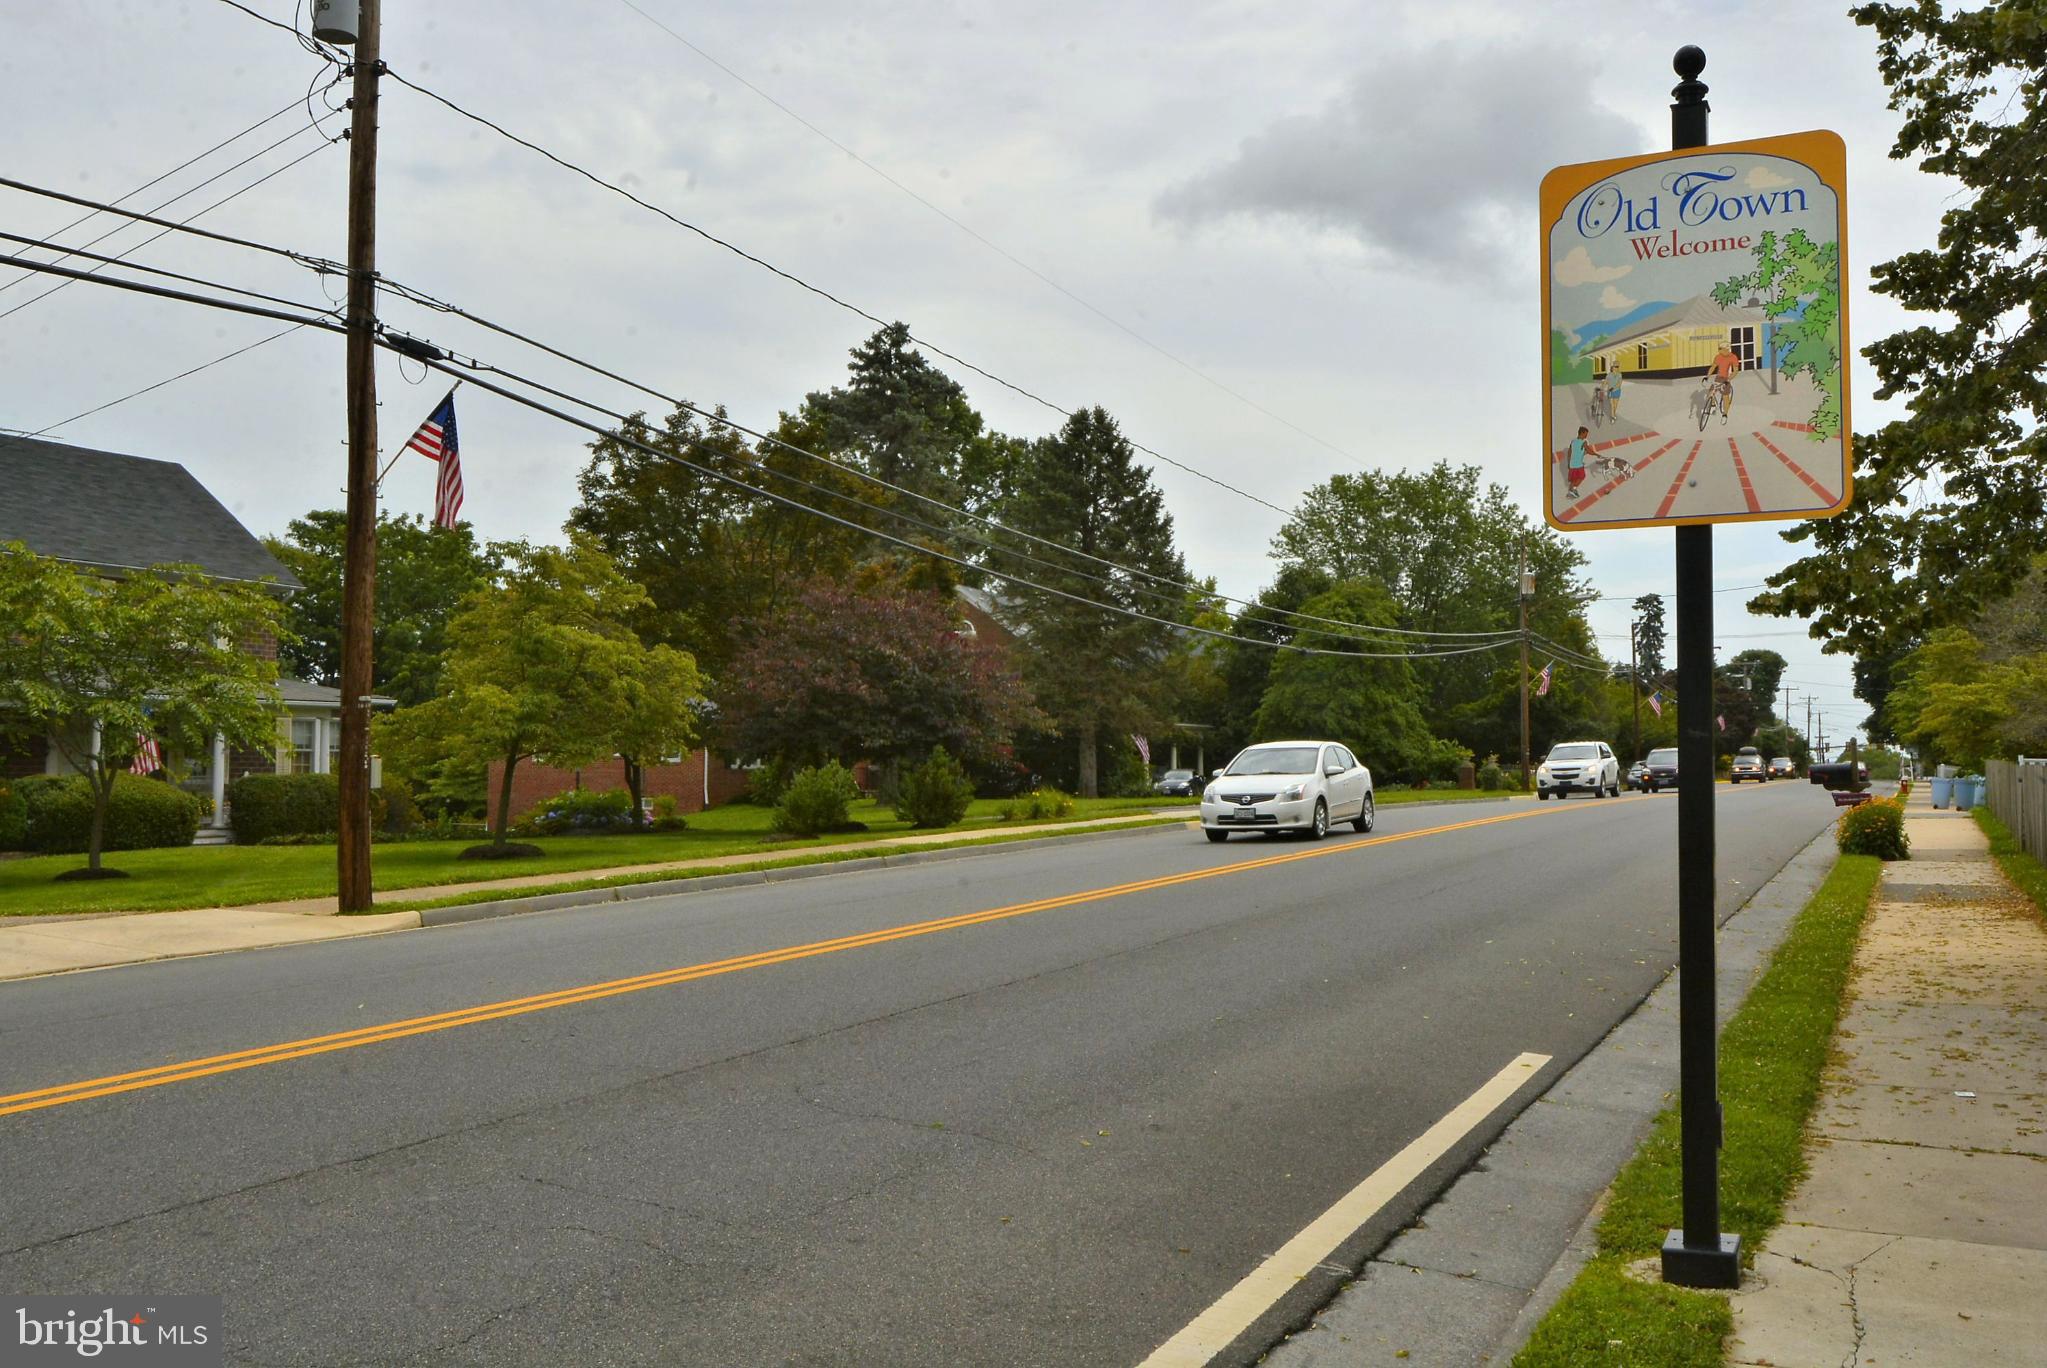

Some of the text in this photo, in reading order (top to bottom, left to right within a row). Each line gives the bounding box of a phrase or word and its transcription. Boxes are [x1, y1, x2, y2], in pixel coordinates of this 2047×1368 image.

[1577, 166, 1808, 239] Old Town
[1629, 229, 1751, 261] Welcome
